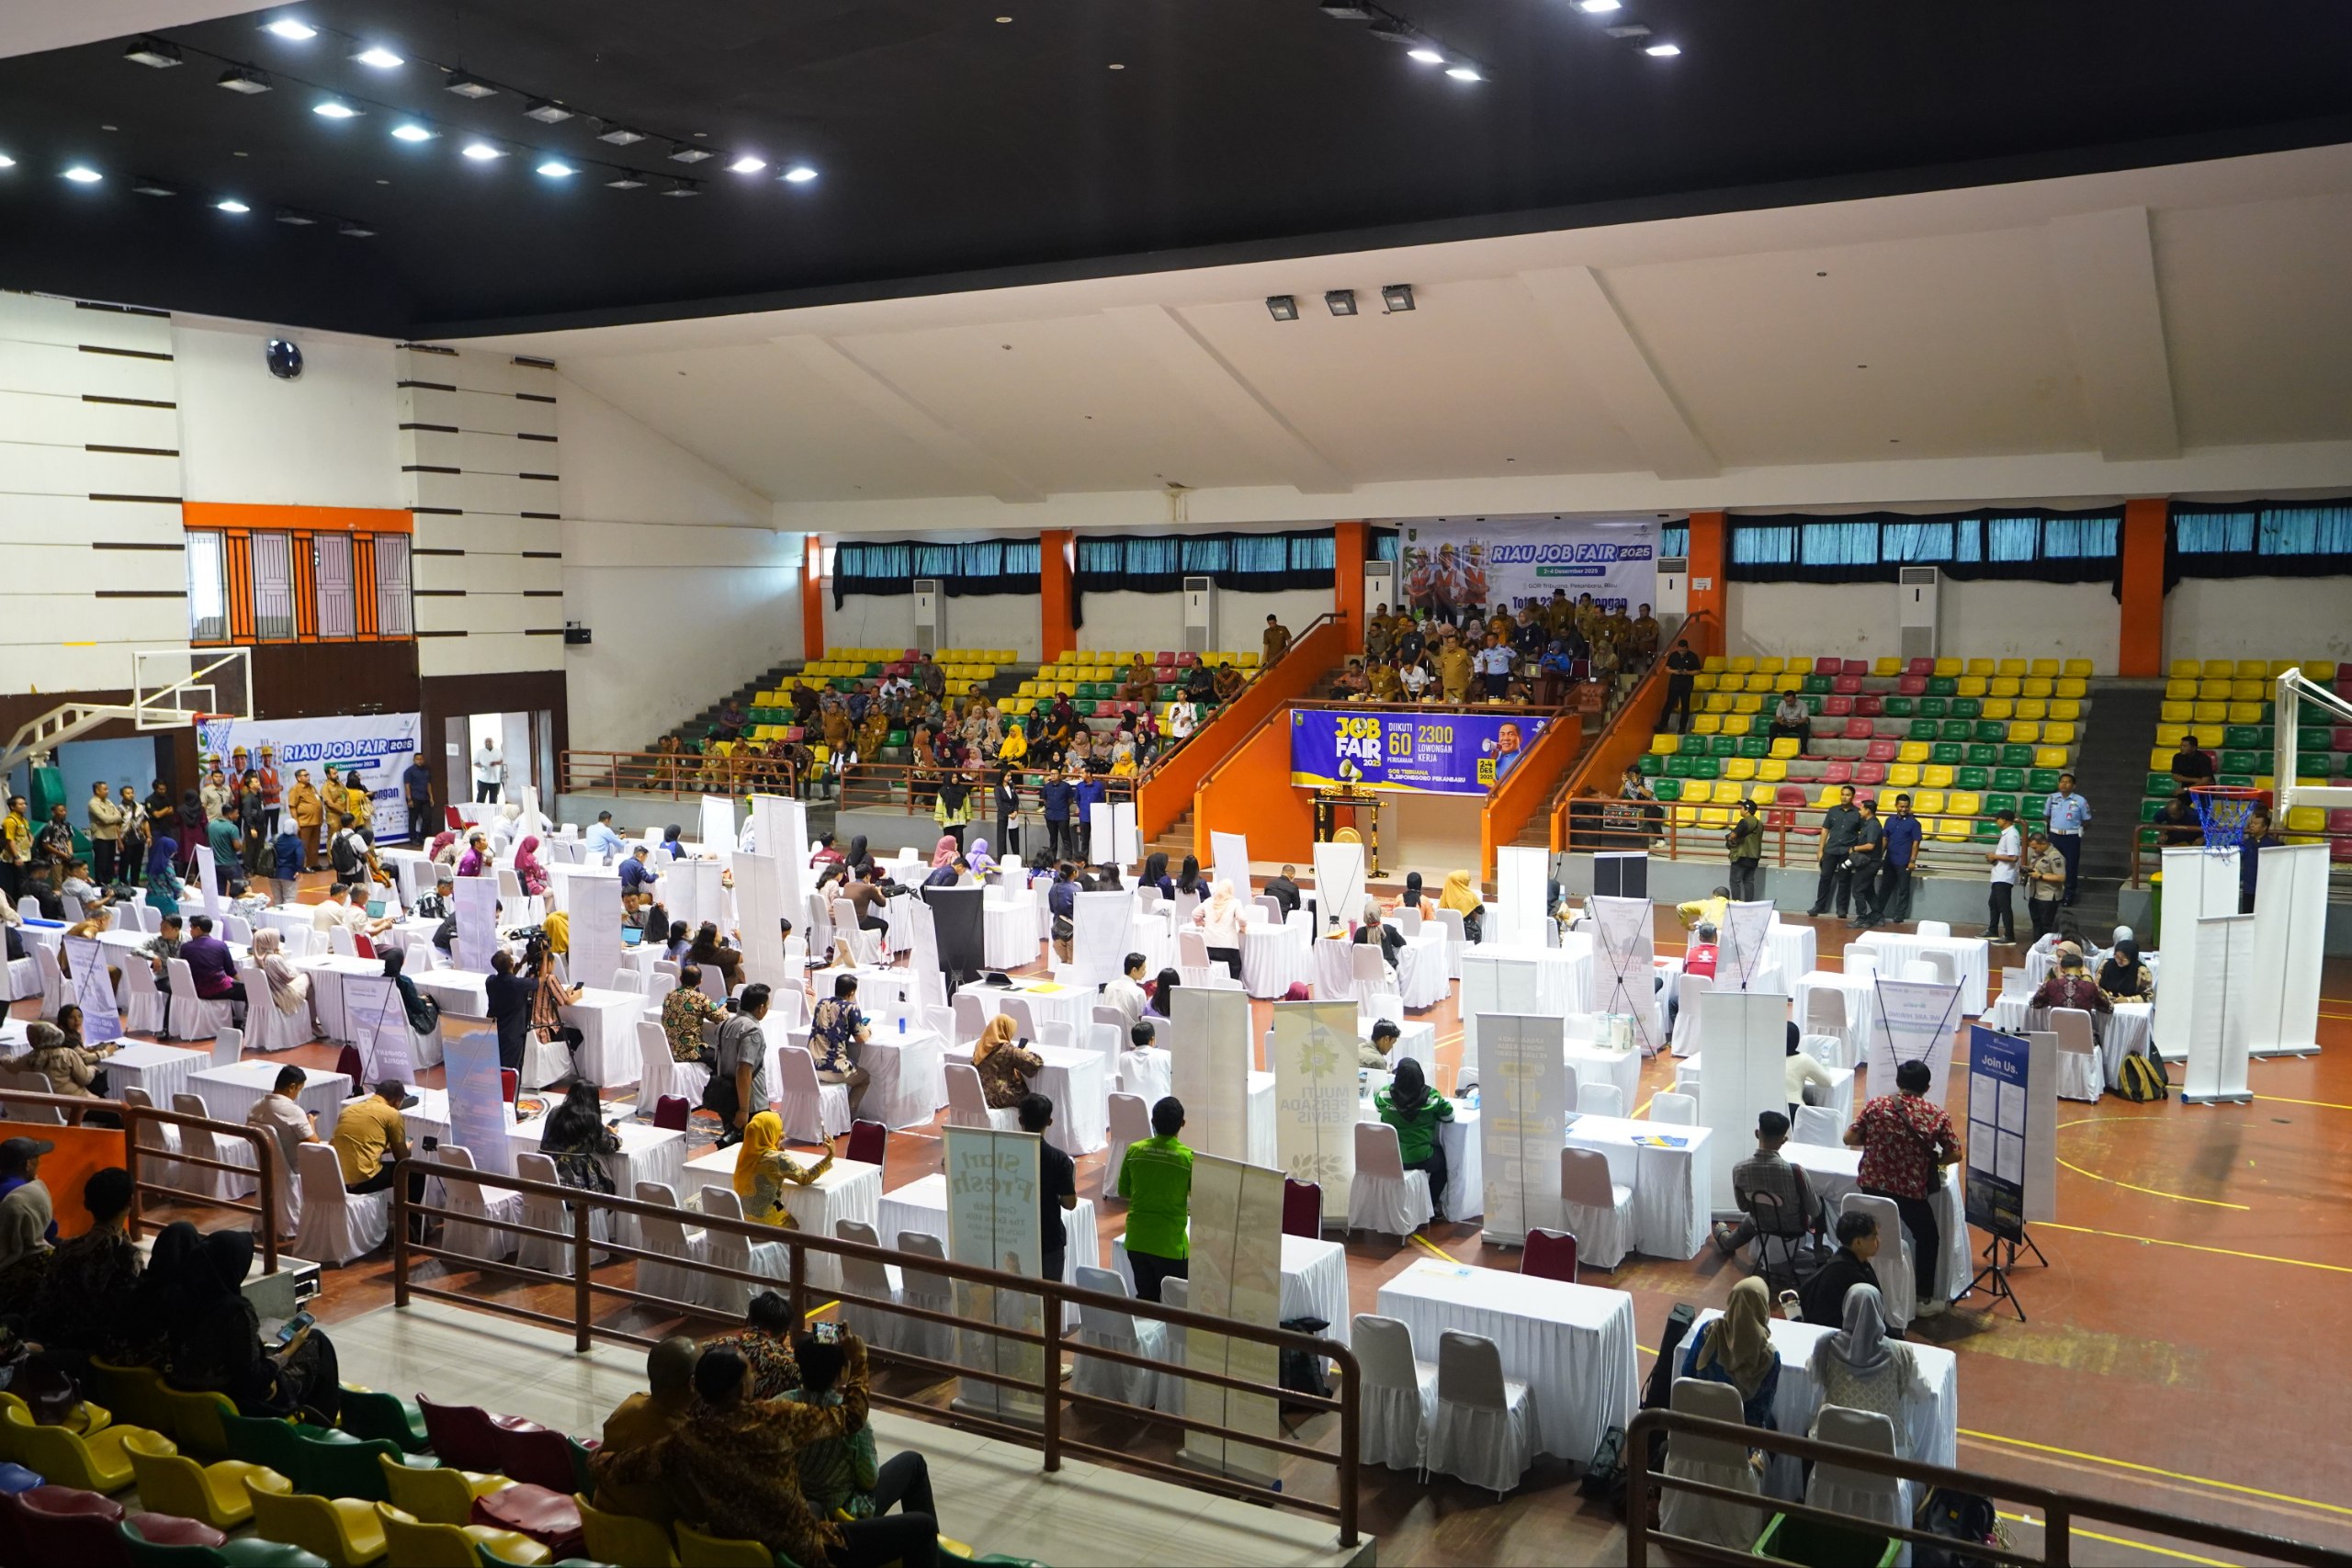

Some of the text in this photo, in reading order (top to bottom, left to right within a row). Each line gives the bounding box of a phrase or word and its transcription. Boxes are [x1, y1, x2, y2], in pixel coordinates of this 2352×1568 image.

[1492, 545, 1650, 562] RIAU JOB FAIR 2025
[1335, 717, 1381, 739] JOB
[1388, 723, 1413, 732] DIIKUTI
[1418, 726, 1453, 743] 2300
[284, 739, 413, 761] RIAU JOB FAIR 2025
[1336, 738, 1381, 761] FAIR
[1389, 733, 1412, 756] 60
[1418, 745, 1453, 753] LOWONGAN
[339, 761, 364, 770] Desember
[1363, 759, 1381, 767] 2025
[1418, 754, 1437, 762] KERJA
[1981, 1054, 2002, 1069] Join
[2003, 1060, 2018, 1075] Us.
